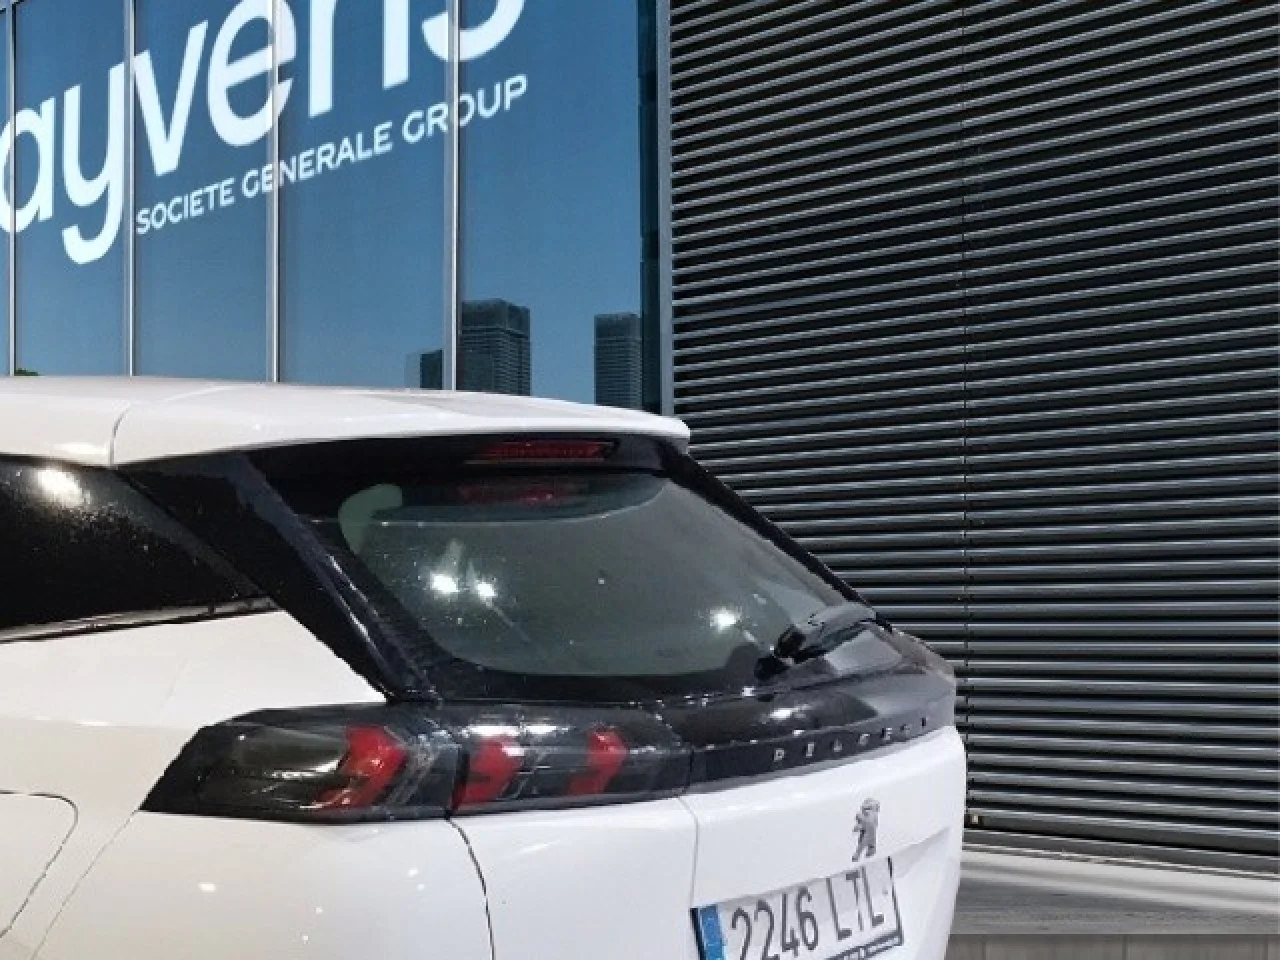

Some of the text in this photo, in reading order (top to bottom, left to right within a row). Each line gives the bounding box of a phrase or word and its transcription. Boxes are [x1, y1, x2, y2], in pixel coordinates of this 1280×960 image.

[135, 73, 528, 235] SOCIETE GENERALE GROUP
[825, 865, 885, 941] LTL
